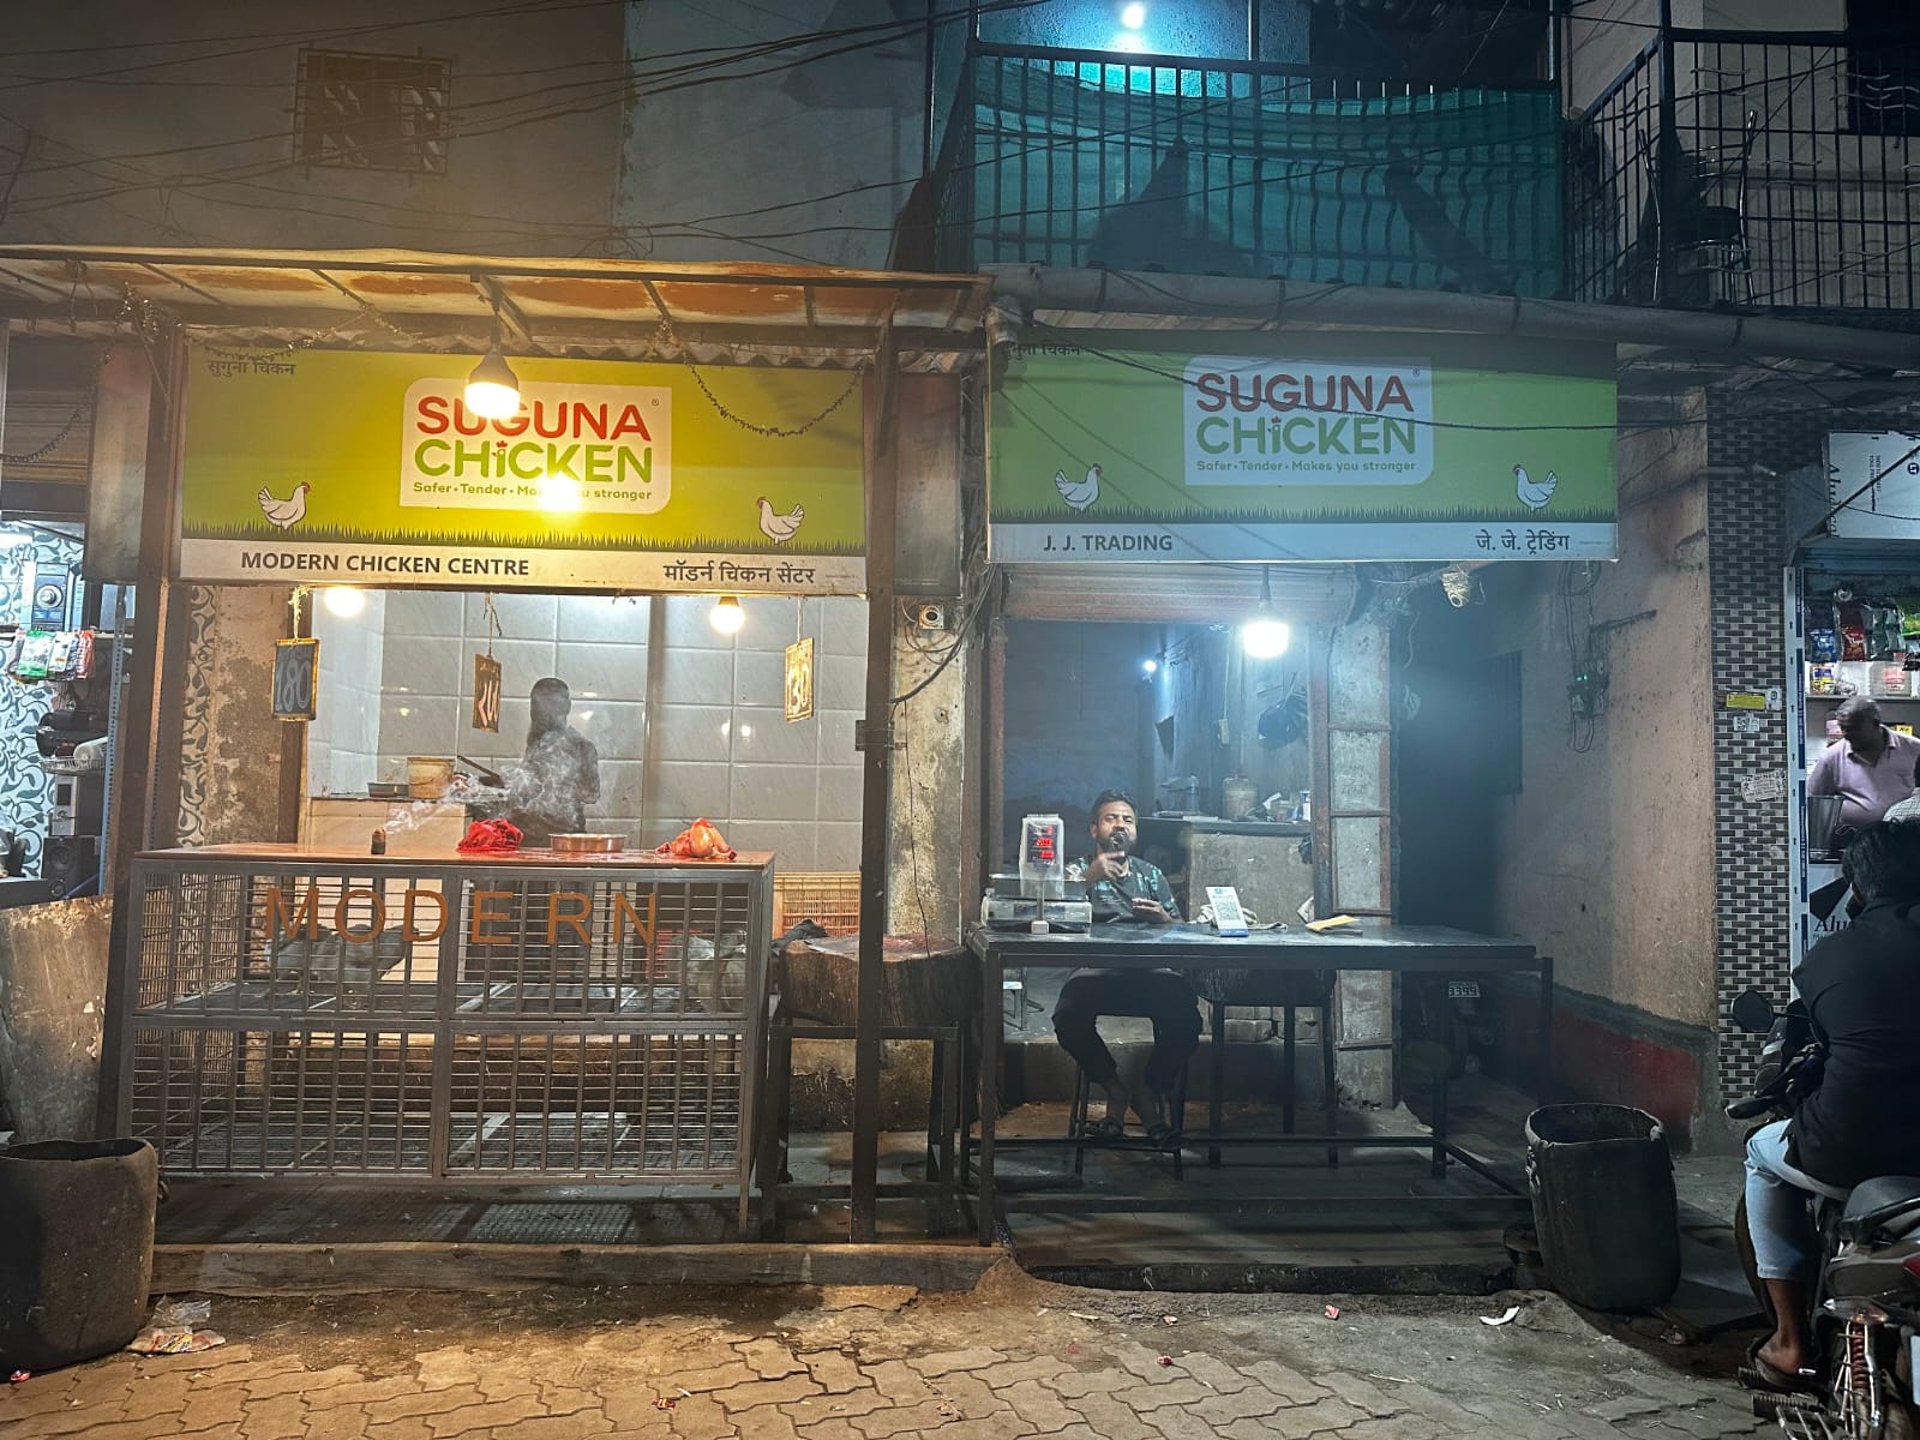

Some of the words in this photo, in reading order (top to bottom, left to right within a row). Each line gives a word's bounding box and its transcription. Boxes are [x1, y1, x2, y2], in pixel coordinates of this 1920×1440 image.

[1196, 373, 1415, 413] SUGUNA
[416, 395, 652, 442] SUGUNA
[1196, 460, 1231, 472] Safer
[1239, 460, 1282, 472] Tender
[1291, 460, 1332, 472] Makes
[1336, 462, 1359, 473] you
[1363, 461, 1416, 473] stronger
[413, 481, 452, 494] Safer
[459, 482, 507, 496] Tender
[593, 489, 653, 502] stronger
[1043, 534, 1057, 551] J.
[1062, 534, 1076, 551] J.
[1081, 534, 1173, 551] TRADING
[1475, 528, 1497, 551] जे.
[1501, 528, 1522, 551] जे.
[1525, 528, 1571, 555] ट्रेडिंग
[241, 551, 339, 570] MODERN
[346, 554, 440, 573] CHICKEN
[447, 557, 529, 576] CENTRE
[663, 559, 715, 582] मॉडर्न
[718, 561, 772, 583] चिकन
[776, 561, 816, 584] सेंटर
[264, 886, 656, 945] MODERN
